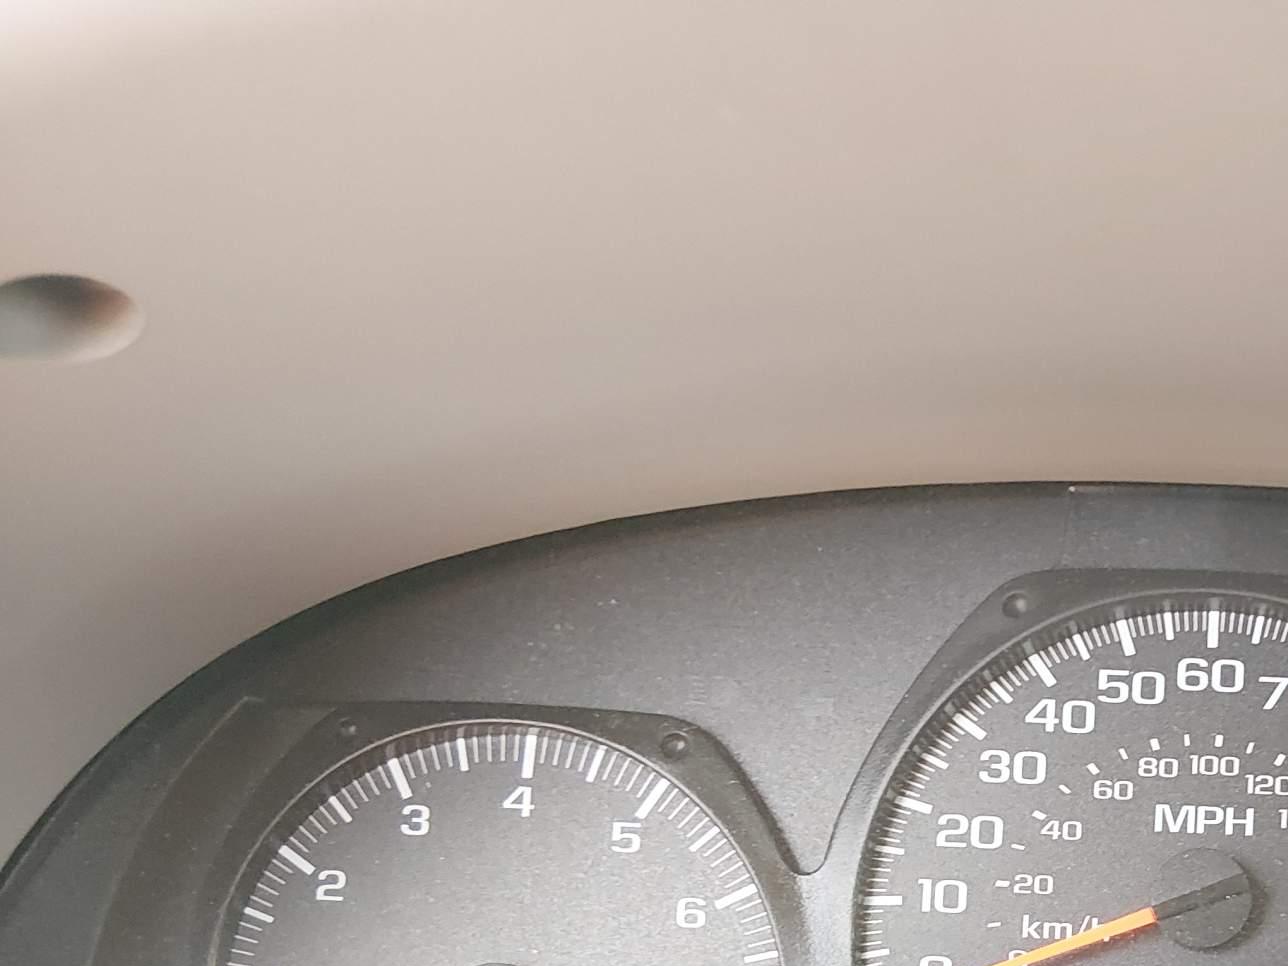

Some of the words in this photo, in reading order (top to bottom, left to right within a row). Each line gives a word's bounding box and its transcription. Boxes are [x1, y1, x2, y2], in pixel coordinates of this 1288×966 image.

[1098, 670, 1164, 704] 50
[1177, 658, 1244, 692] 60
[1025, 699, 1095, 733] 40
[979, 750, 1046, 784] 30
[1138, 758, 1178, 777] 80
[1190, 755, 1239, 776] 100
[503, 786, 535, 817] 4
[1094, 780, 1133, 800] 60
[401, 805, 429, 835] 3
[936, 814, 1003, 848] 20
[1040, 821, 1082, 840] 40
[1154, 804, 1254, 836] MPH
[611, 822, 641, 852] 5
[316, 870, 346, 901] 2
[918, 879, 967, 913] 10
[1014, 874, 1053, 894] 20
[676, 898, 706, 928] 6
